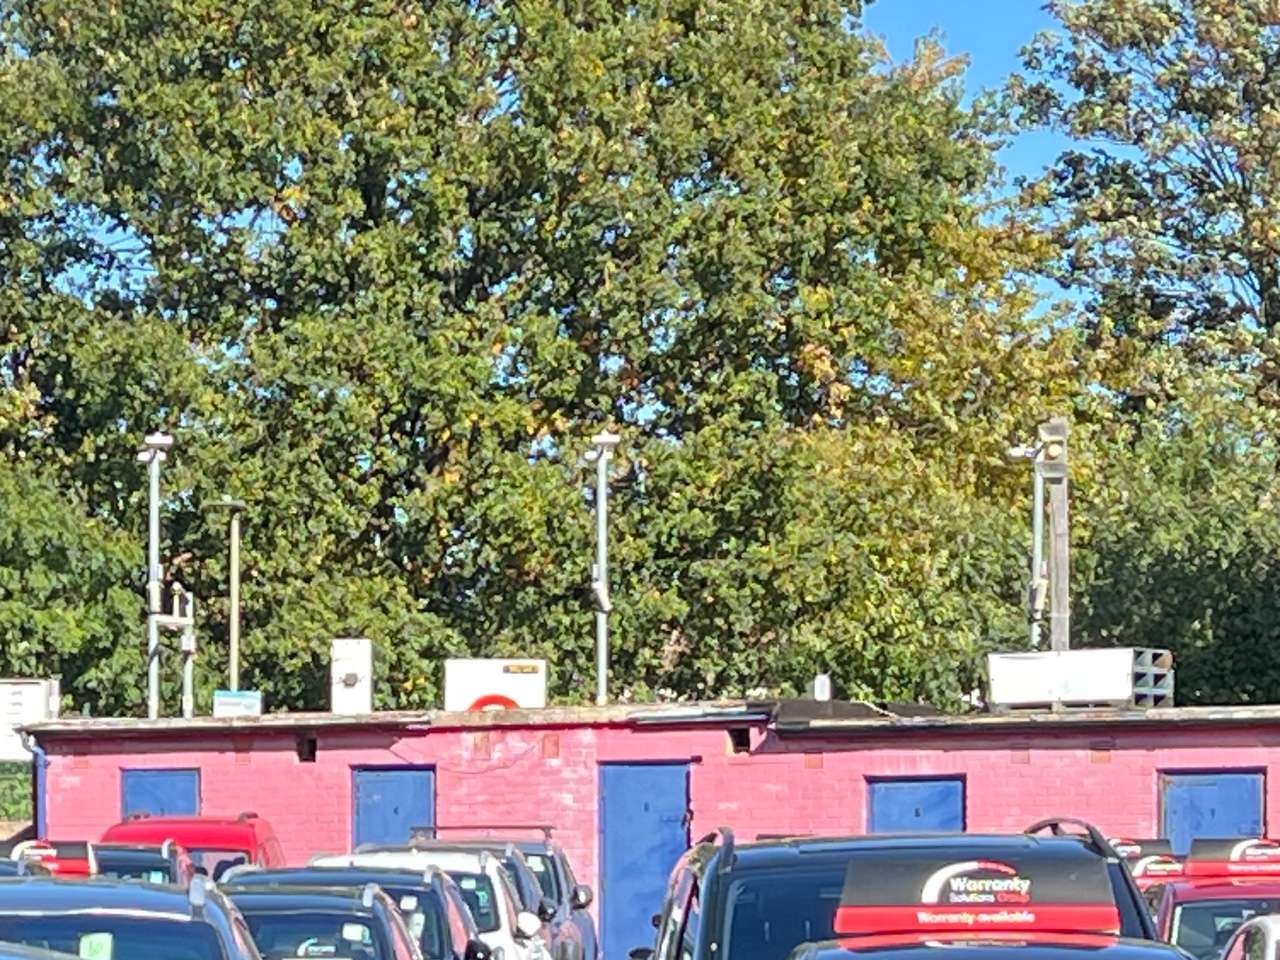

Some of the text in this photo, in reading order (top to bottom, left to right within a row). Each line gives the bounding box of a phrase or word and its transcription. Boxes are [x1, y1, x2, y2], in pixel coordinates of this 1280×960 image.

[950, 877, 1030, 895] Warranty
[917, 911, 1035, 925] Warranty available
